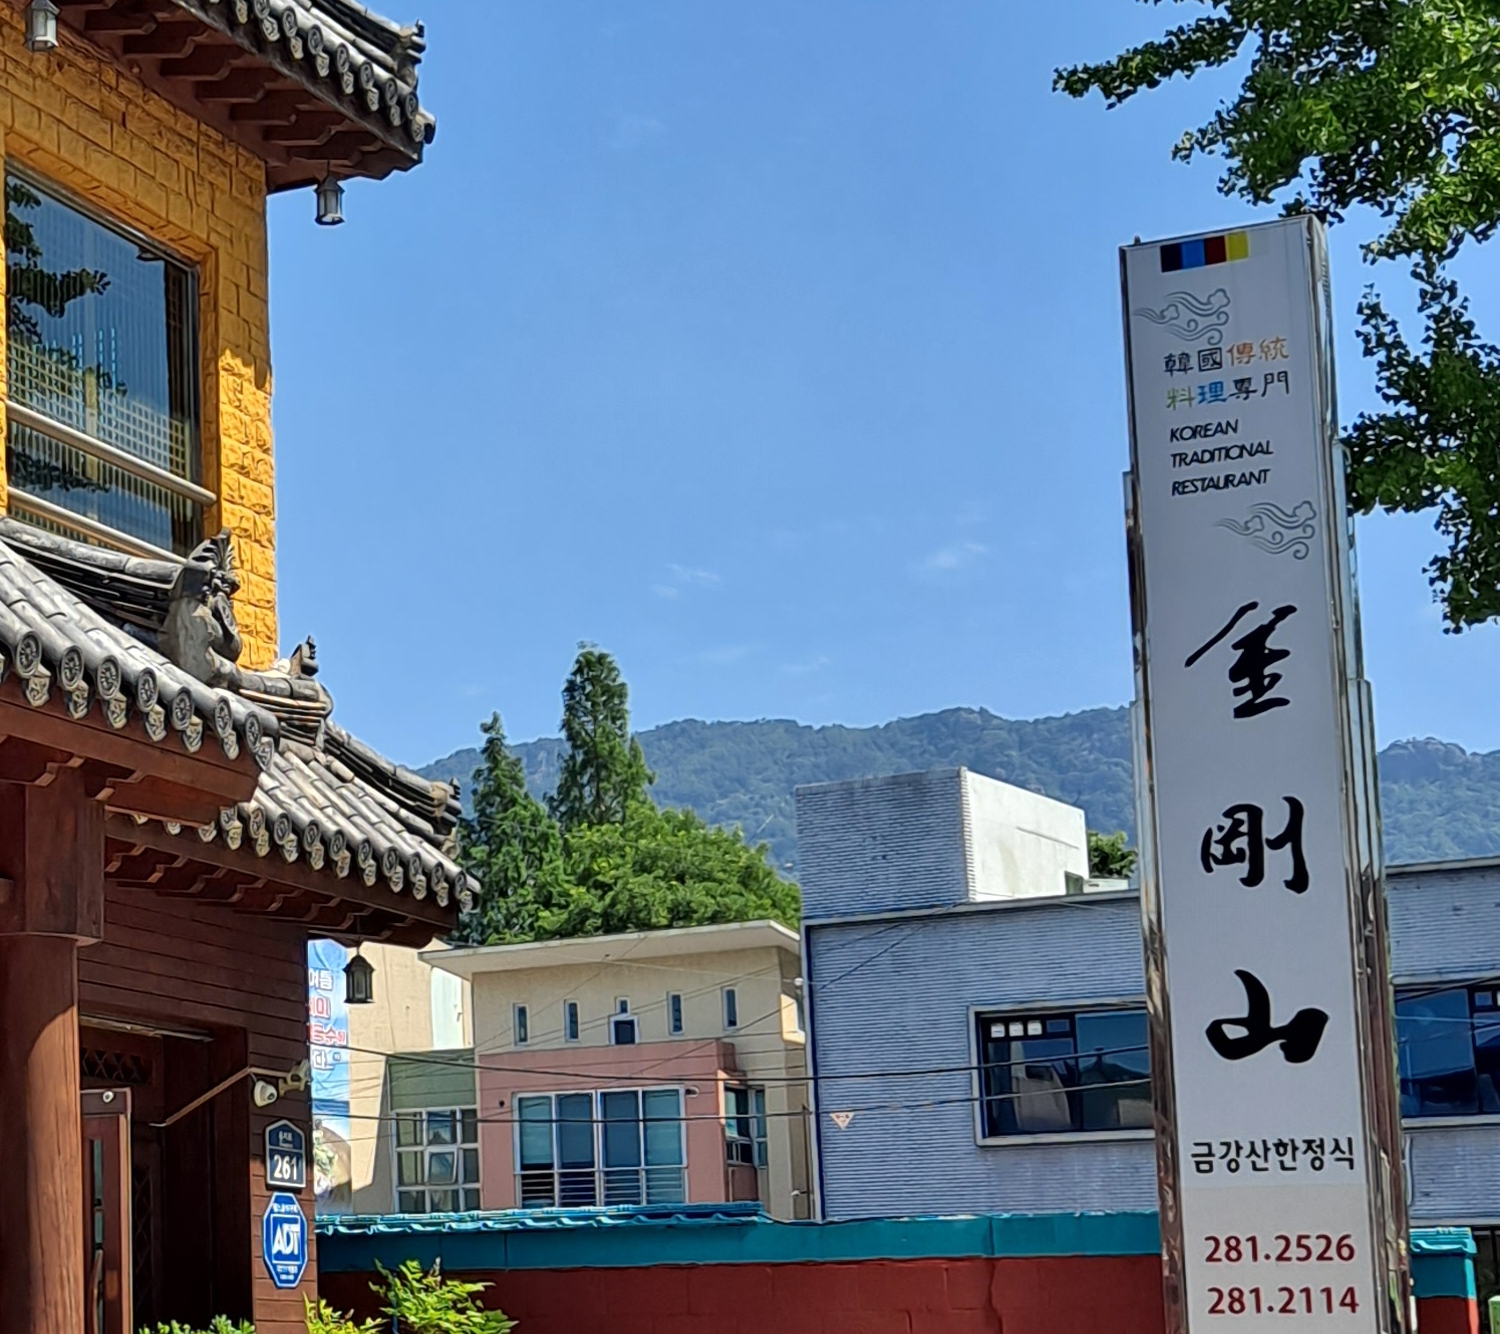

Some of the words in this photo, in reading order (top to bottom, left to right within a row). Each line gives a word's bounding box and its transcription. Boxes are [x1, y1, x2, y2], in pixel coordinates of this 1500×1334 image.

[1163, 336, 1290, 377] 韓國傳統
[1169, 418, 1239, 443] KOREAN
[1170, 439, 1275, 469] TRADITIONAL
[1171, 468, 1272, 497] RESTAURANT
[1184, 600, 1330, 1064] 金剛山
[273, 1154, 297, 1181] 261
[1190, 1136, 1356, 1174] 금강산한정식
[272, 1223, 300, 1256] ADT
[1203, 1233, 1356, 1263] 281.2526
[1206, 1286, 1360, 1315] 281.2114
